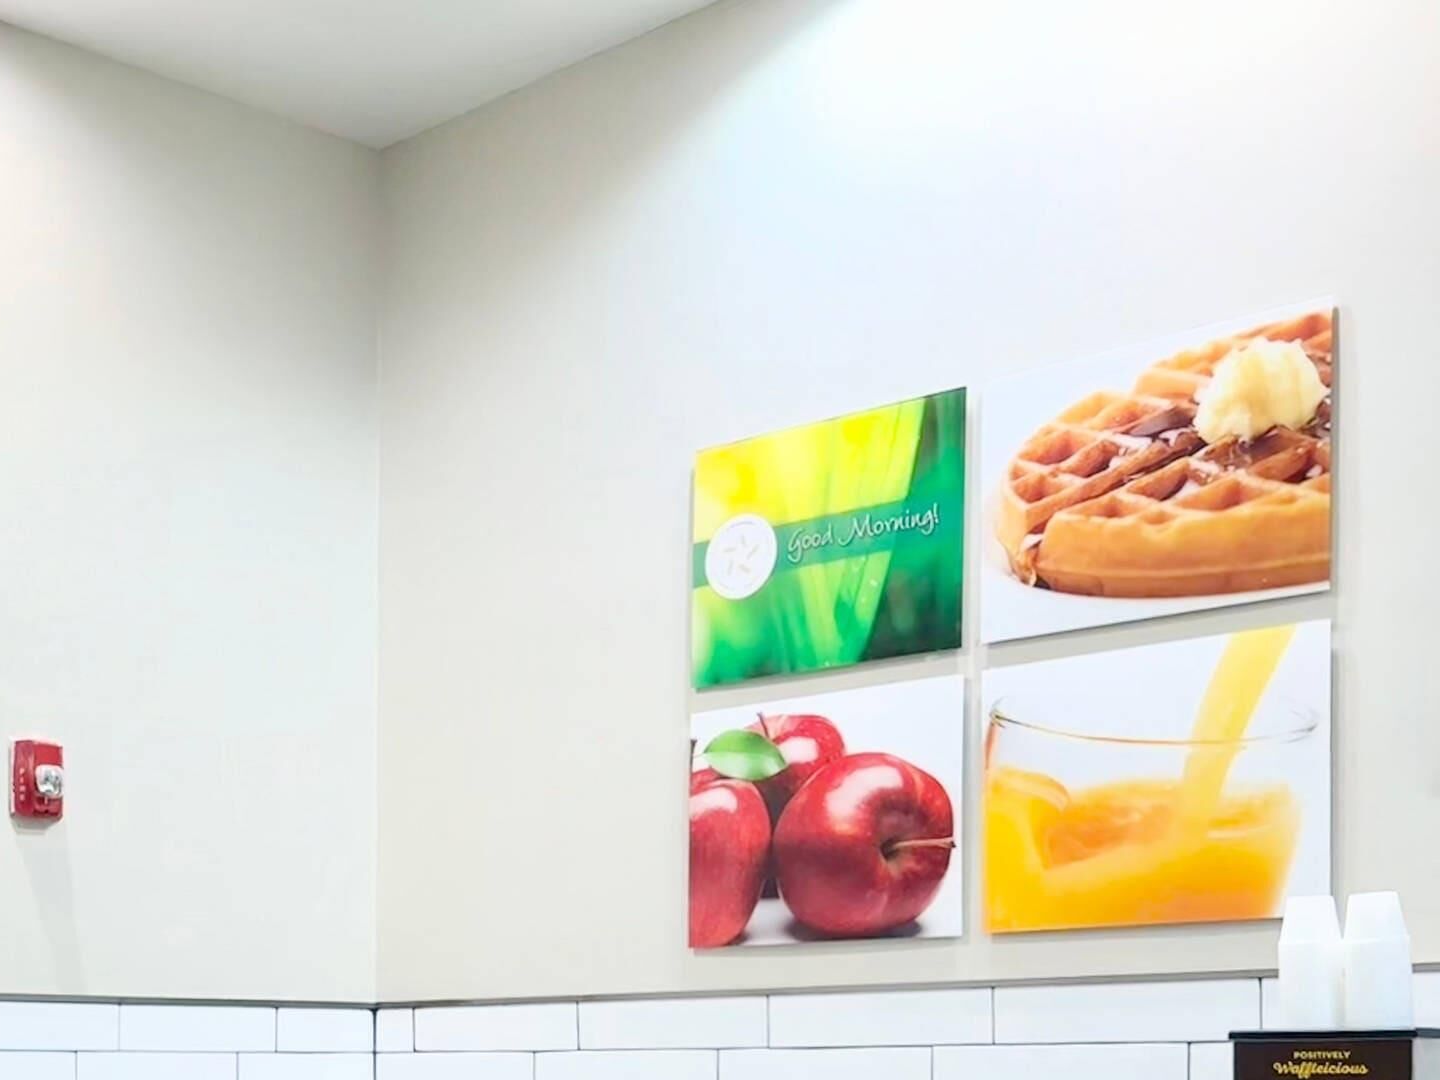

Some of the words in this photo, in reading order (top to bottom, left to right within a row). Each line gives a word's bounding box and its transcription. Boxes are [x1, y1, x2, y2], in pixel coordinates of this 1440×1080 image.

[788, 523, 833, 563] Good
[838, 502, 939, 546] Morning!
[1293, 1050, 1351, 1059] POSITIVELY
